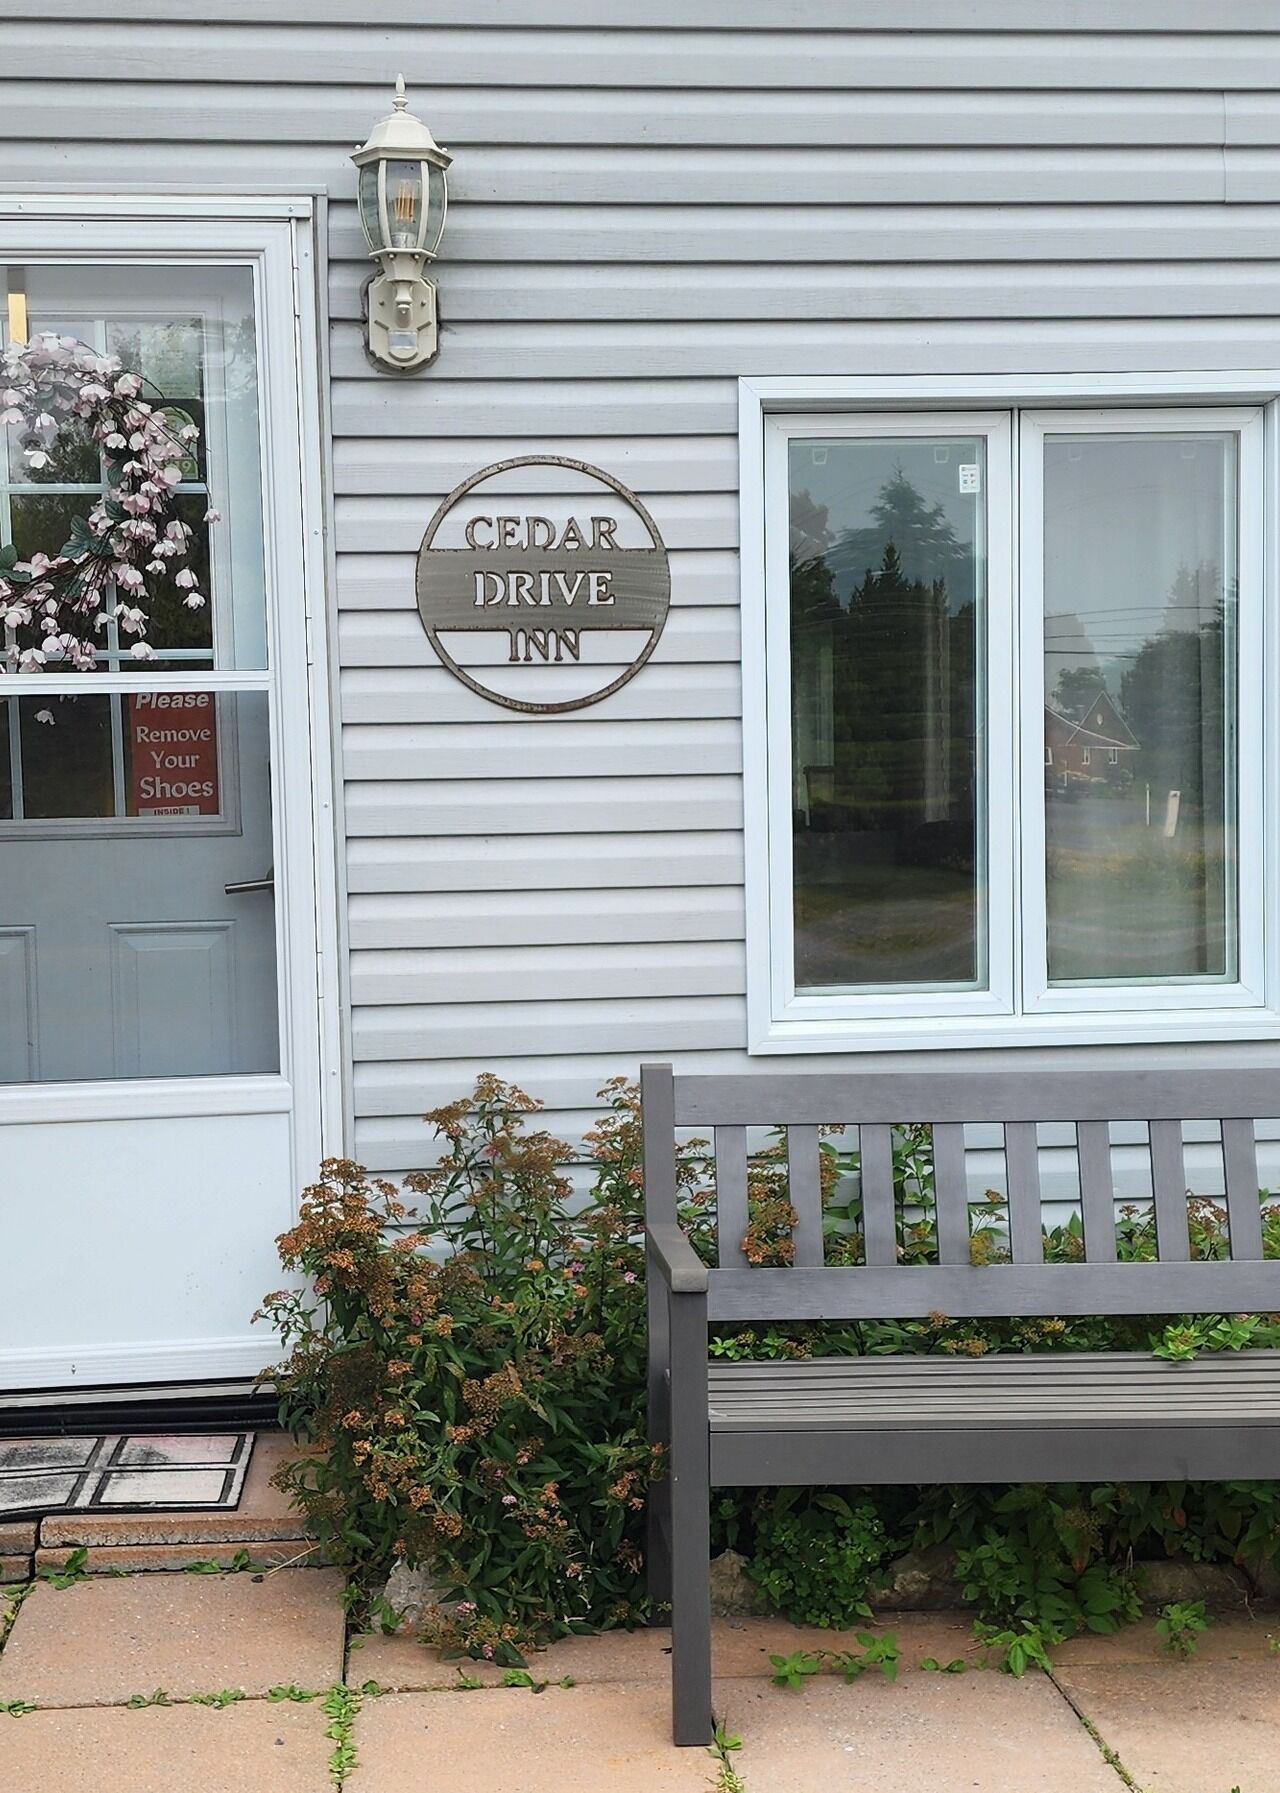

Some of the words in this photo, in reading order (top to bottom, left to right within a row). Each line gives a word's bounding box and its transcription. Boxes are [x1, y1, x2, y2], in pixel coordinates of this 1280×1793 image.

[465, 516, 620, 550] CEDAR
[474, 570, 616, 607] DRIVE
[508, 628, 582, 661] INN
[135, 692, 209, 709] Please
[136, 726, 211, 743] Remove
[150, 750, 200, 769] Your
[140, 776, 214, 799] Shoes
